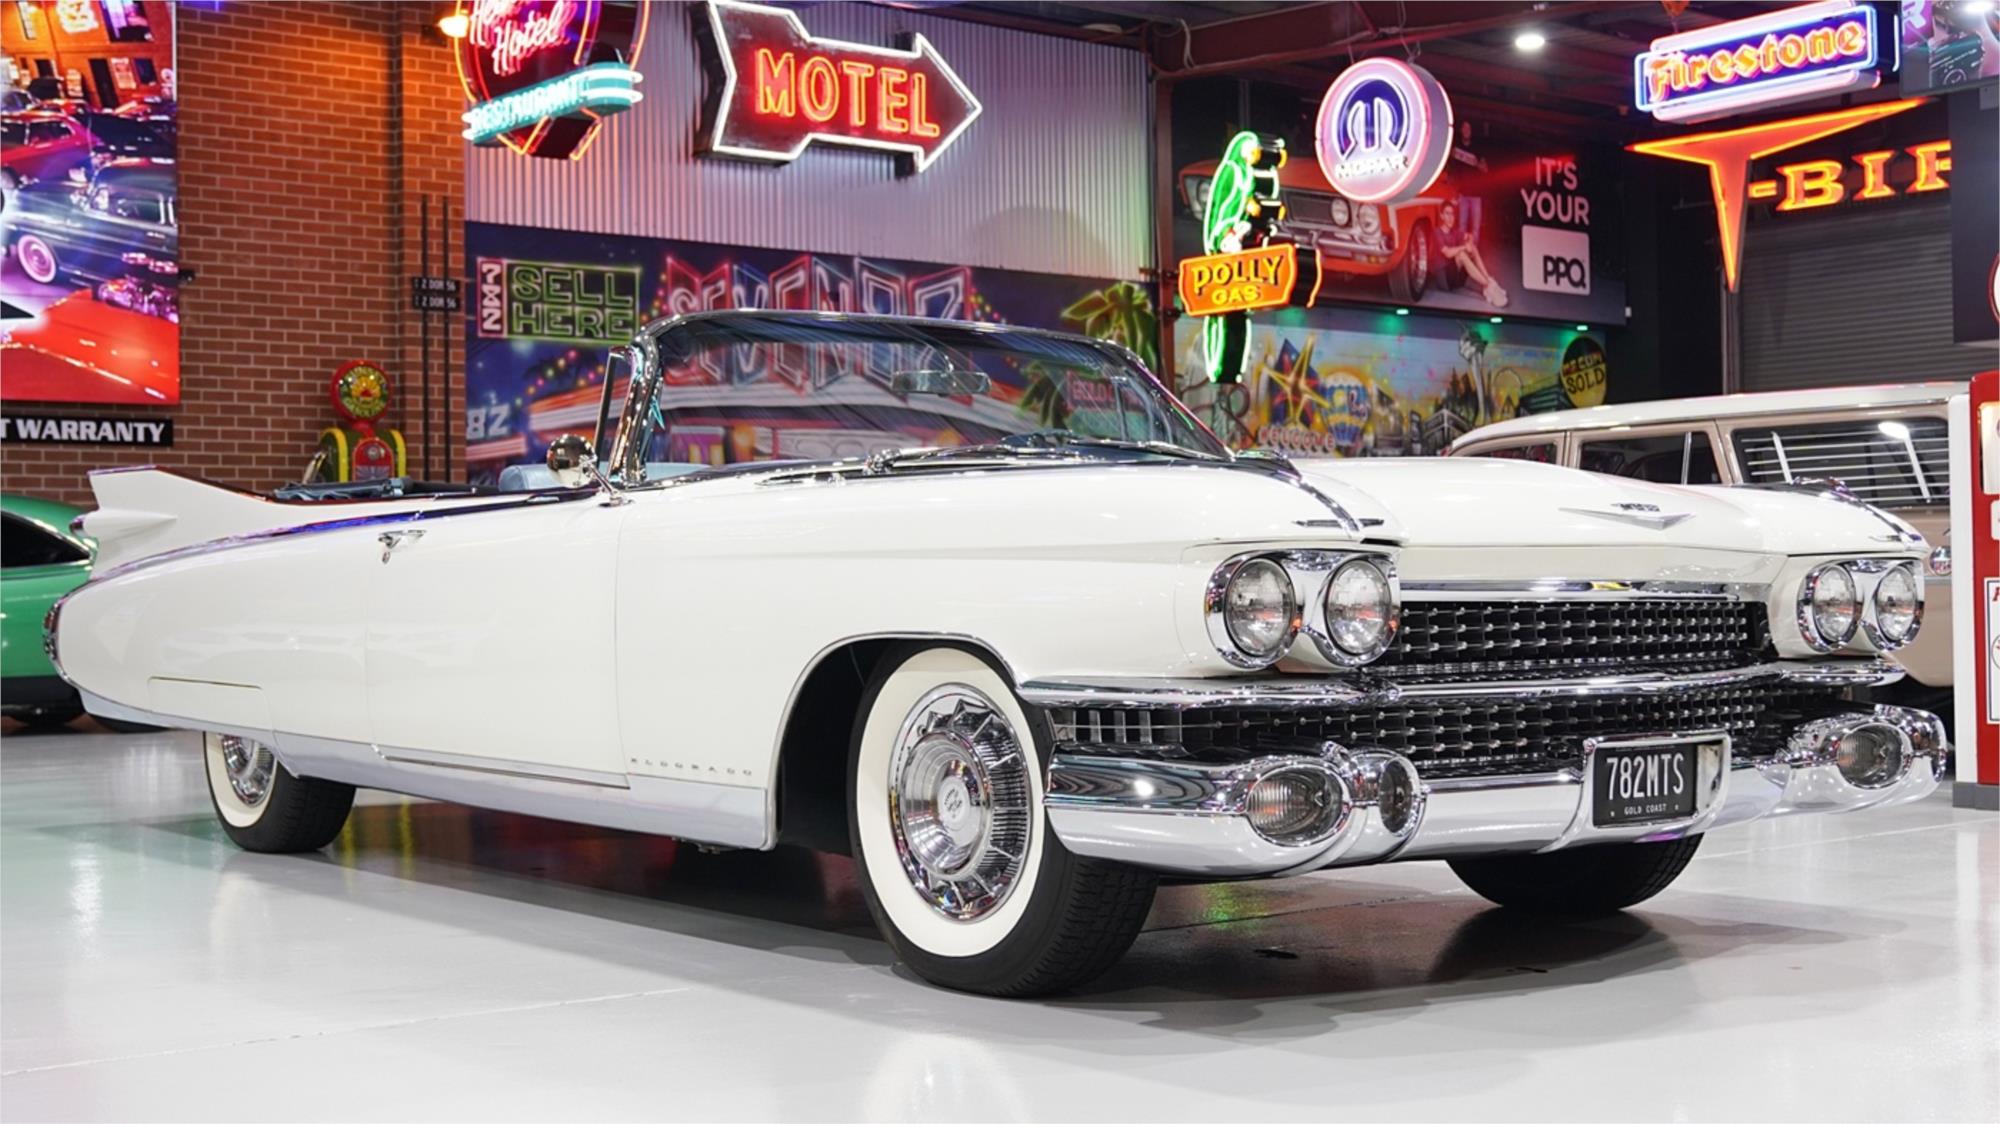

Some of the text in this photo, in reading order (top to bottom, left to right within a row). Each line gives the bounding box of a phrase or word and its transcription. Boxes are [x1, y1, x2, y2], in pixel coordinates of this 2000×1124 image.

[491, 0, 570, 75] Hotel
[1645, 21, 1867, 100] Firestone
[470, 76, 583, 131] RESTAURANT
[756, 48, 940, 137] MOTEL
[1535, 157, 1577, 190] IT'S
[1520, 188, 1589, 225] YOUR
[511, 266, 633, 308] SELL
[1191, 255, 1284, 296] POLLY
[1543, 255, 1587, 289] PPQ
[1211, 285, 1260, 305] GAS
[512, 302, 634, 338] HERE
[1566, 367, 1605, 394] SOLD
[16, 419, 165, 443] WARRANTY
[1259, 428, 1336, 450] WELCOME
[1606, 752, 1684, 800] 782MTS
[1624, 803, 1667, 816] GOLD COAST
